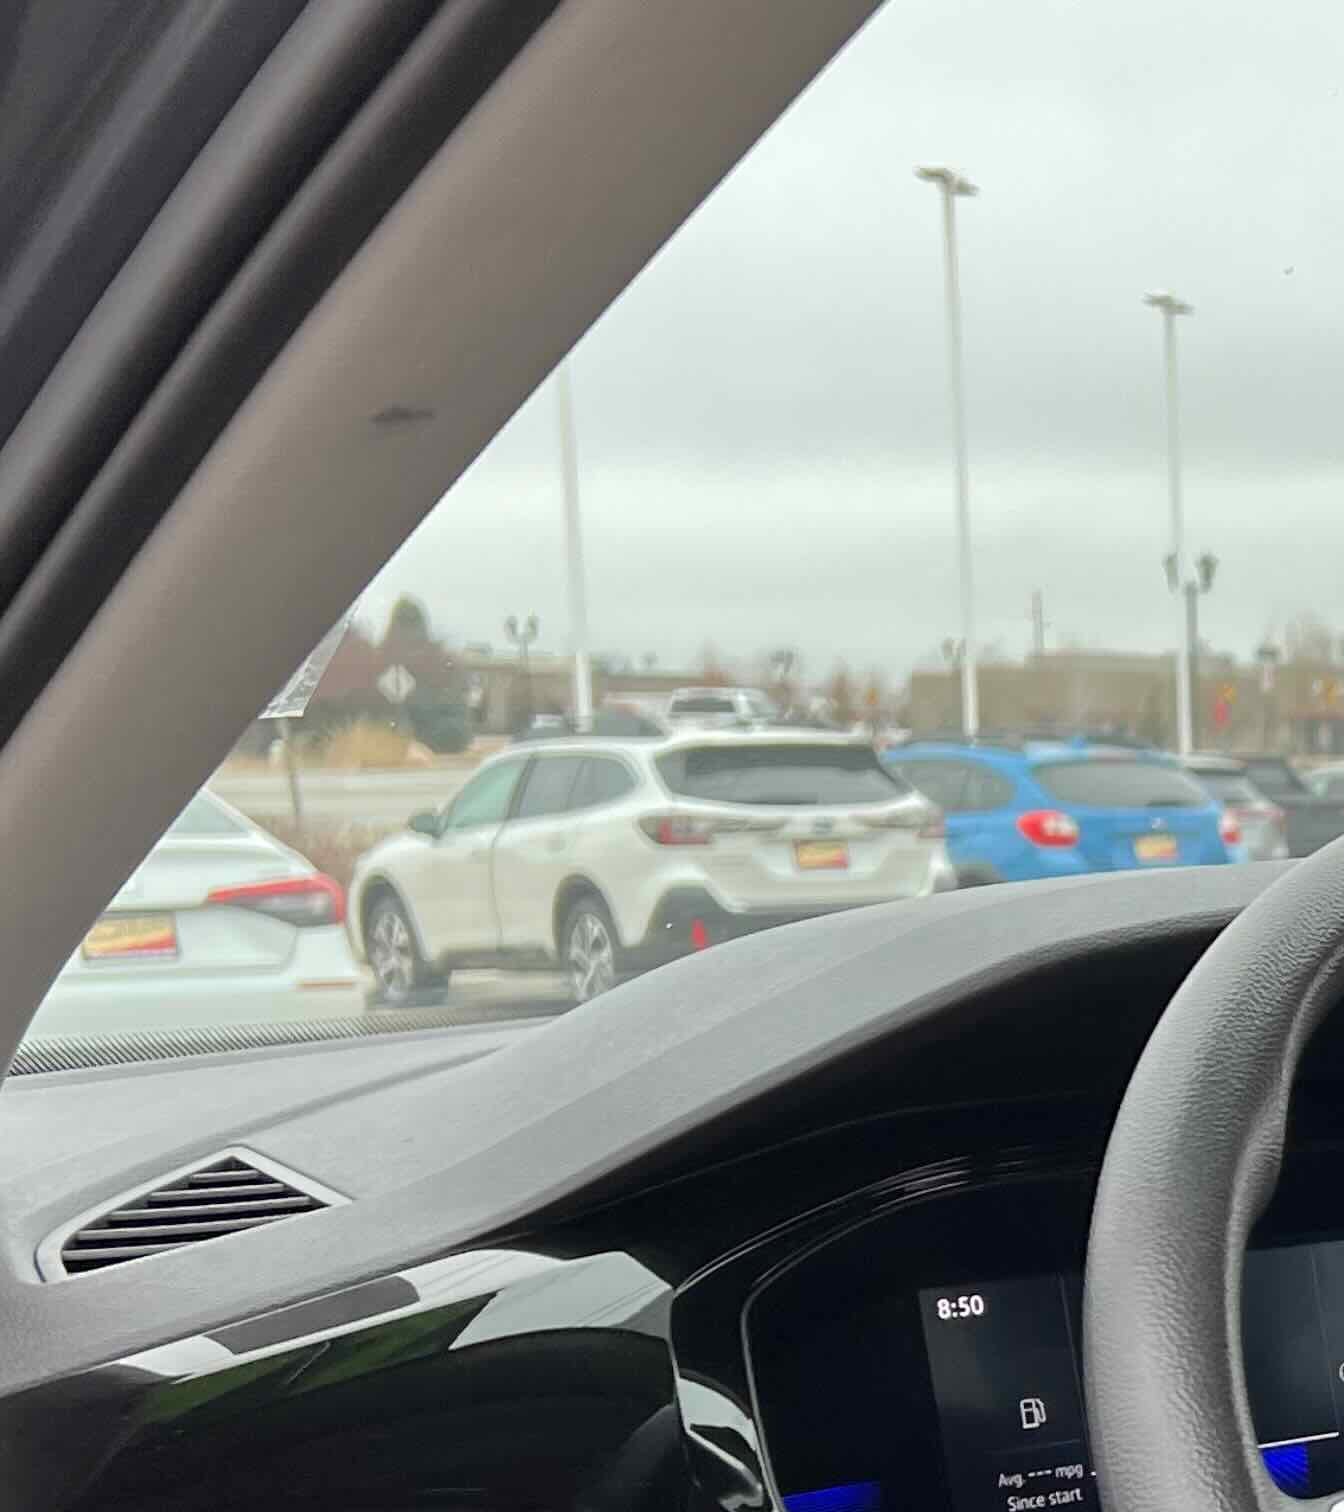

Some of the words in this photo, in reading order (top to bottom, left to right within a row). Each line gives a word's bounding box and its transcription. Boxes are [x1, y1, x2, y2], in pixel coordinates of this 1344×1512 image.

[936, 1294, 984, 1320] 8:50
[998, 1473, 1026, 1489] Avg.
[1055, 1464, 1084, 1480] mpg
[1049, 1487, 1084, 1506] start
